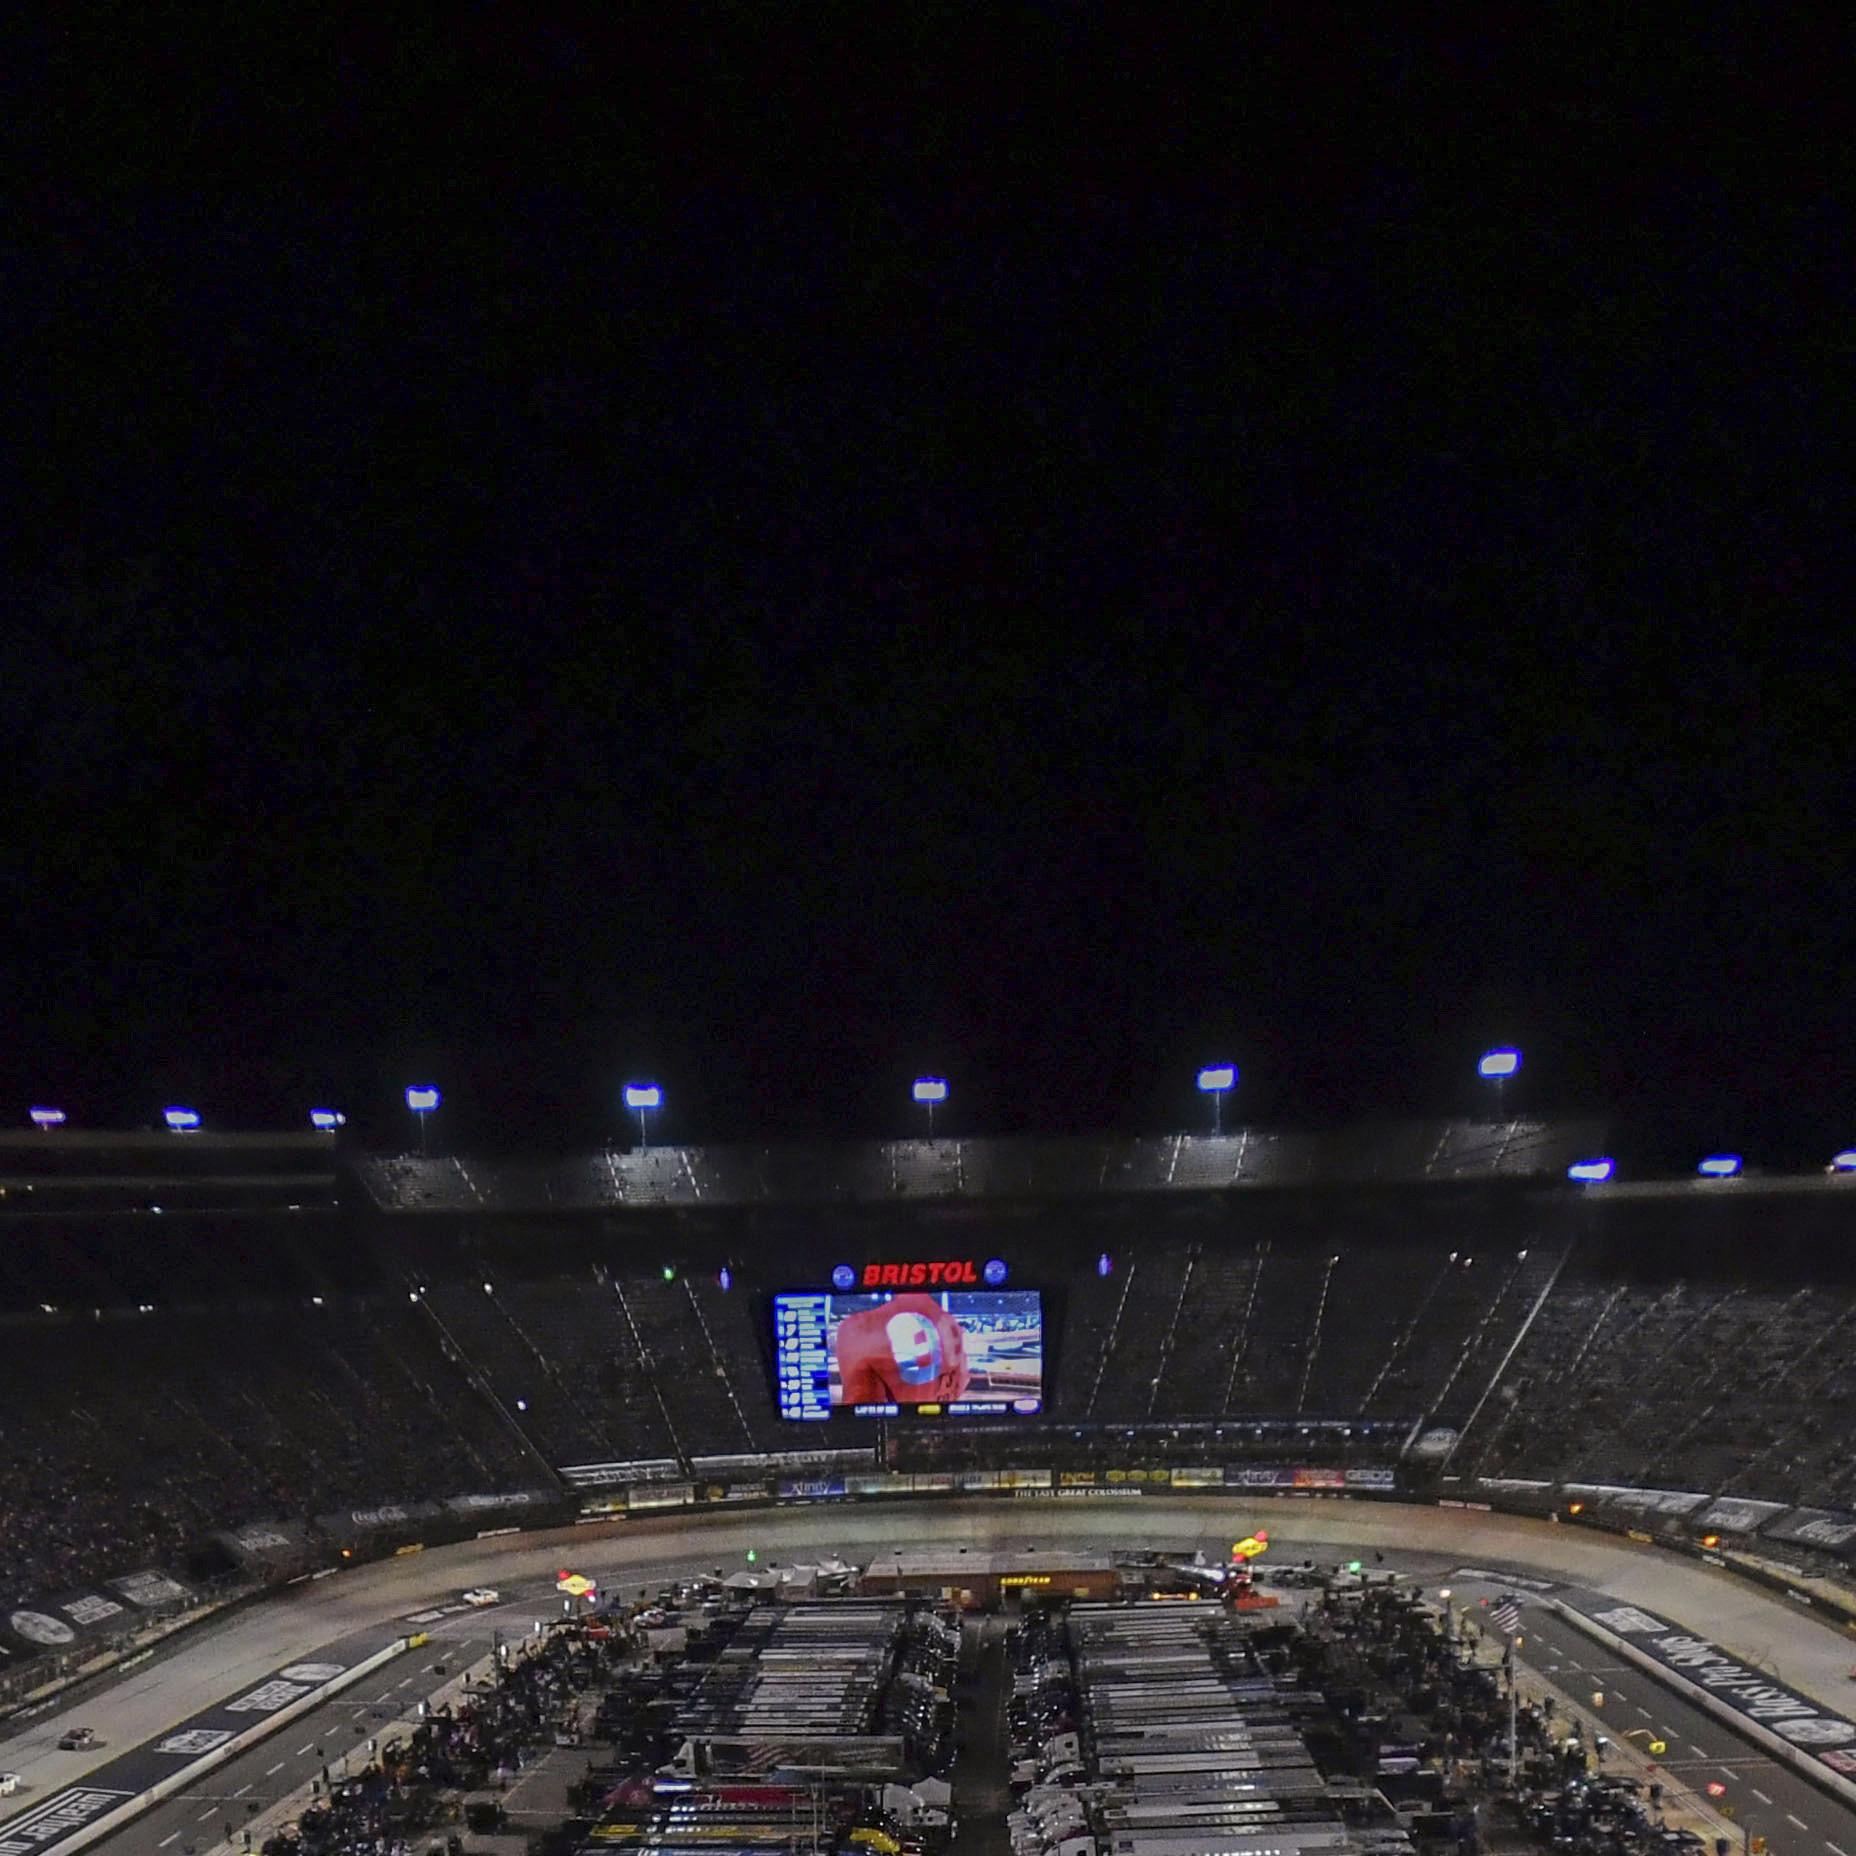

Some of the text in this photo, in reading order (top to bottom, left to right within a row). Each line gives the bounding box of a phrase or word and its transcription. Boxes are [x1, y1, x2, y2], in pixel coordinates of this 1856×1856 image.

[863, 1261, 977, 1287] BRISTOL
[1057, 1489, 1086, 1497] GREAT
[1088, 1488, 1142, 1496] COLOSSEUM
